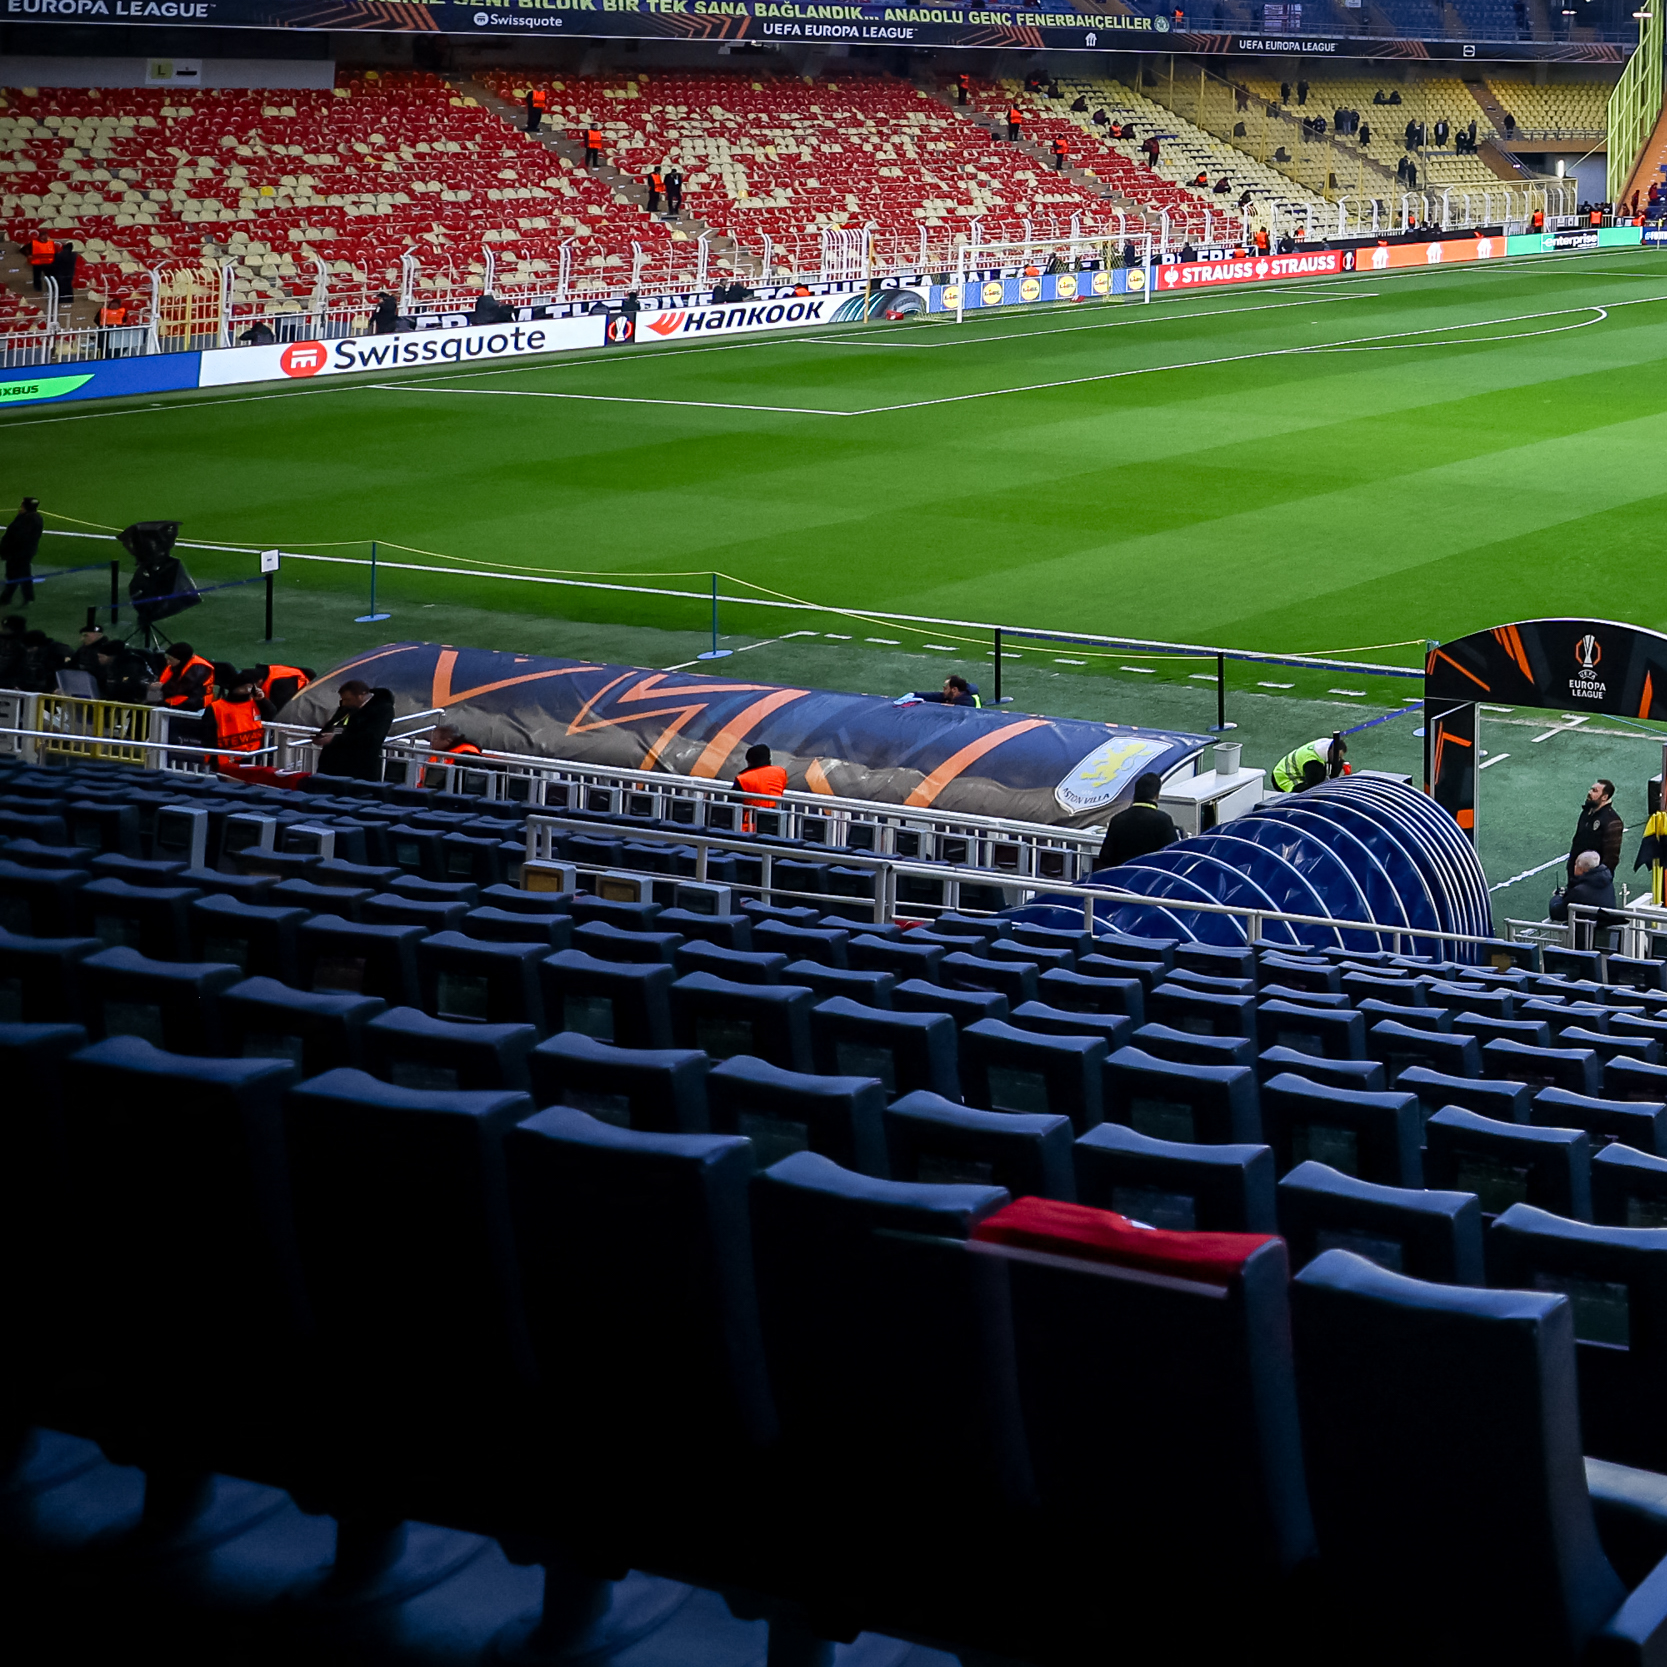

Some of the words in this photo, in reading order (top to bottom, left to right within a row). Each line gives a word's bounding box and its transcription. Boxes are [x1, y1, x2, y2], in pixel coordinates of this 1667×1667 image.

[116, 3, 209, 18] LEAGUE
[694, 1, 749, 16] SANA
[884, 9, 964, 24] ANADOLU
[968, 11, 1012, 27] GENÇ
[1016, 13, 1152, 31] FENERBAHÇELİLER
[490, 13, 564, 29] Swissquote
[763, 22, 801, 35] UEFA
[804, 24, 859, 38] EUROPA
[862, 26, 914, 40] LEAGUE
[1239, 39, 1263, 51] UEFA
[1265, 40, 1301, 52] EUROPA
[1302, 42, 1336, 53] LEAGUE
[1182, 262, 1253, 284] STRAUSS
[1271, 255, 1335, 276] STRAUSS
[334, 326, 546, 370] Swissquote
[1577, 669, 1598, 679] UEFA
[1569, 679, 1607, 691] EUROPA
[1572, 688, 1604, 700] LEAGUE
[1062, 787, 1084, 804] ASTON
[1082, 792, 1110, 805] VILLA
